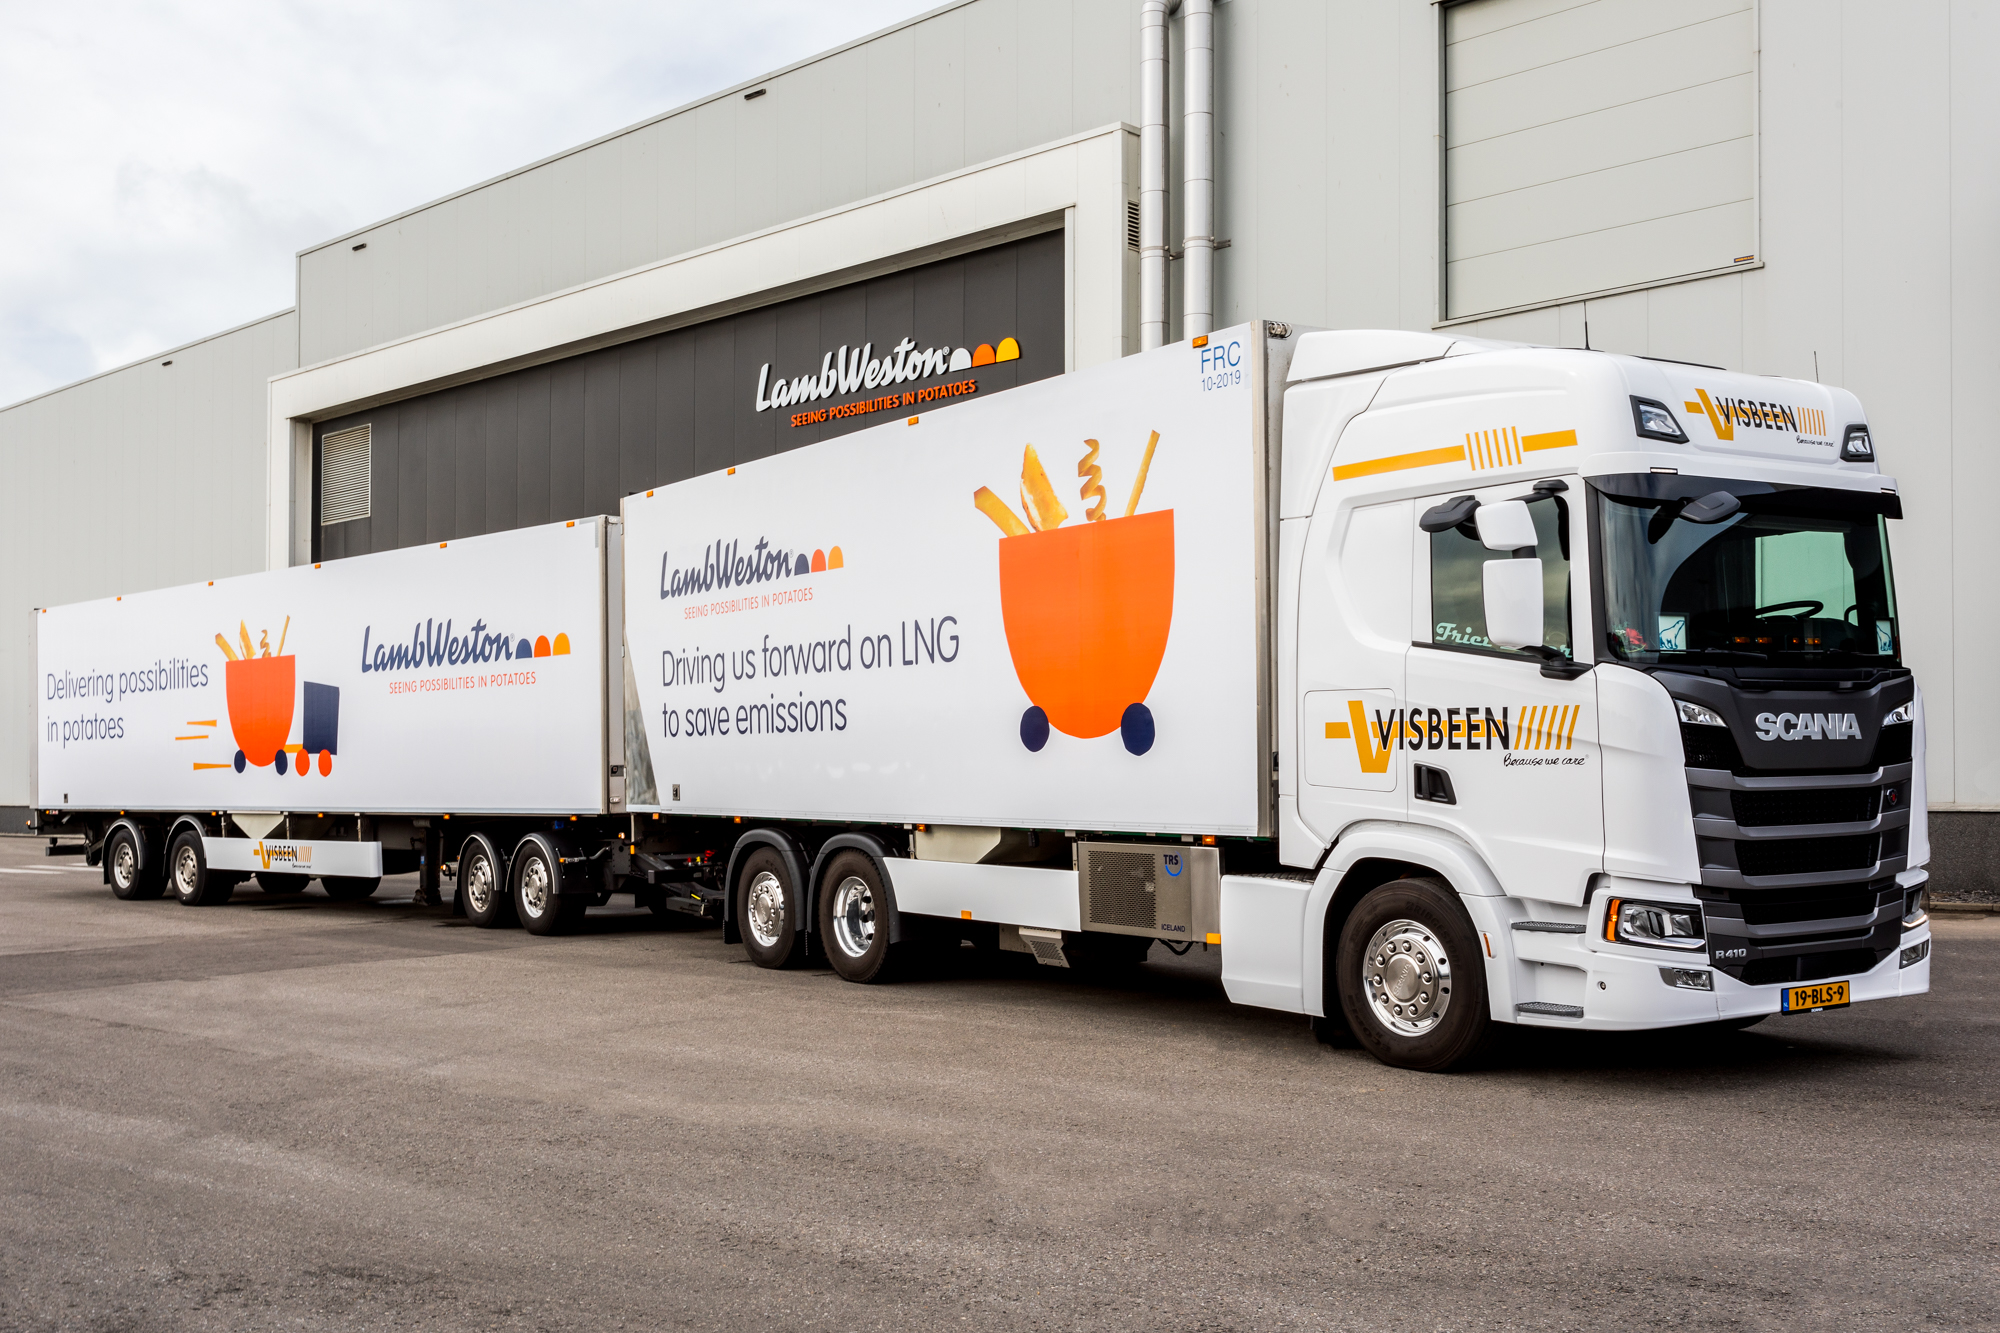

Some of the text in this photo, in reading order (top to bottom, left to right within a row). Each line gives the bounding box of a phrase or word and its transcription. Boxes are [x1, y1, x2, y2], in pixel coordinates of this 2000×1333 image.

[1201, 341, 1241, 374] FRC
[1201, 369, 1241, 392] 10-2019
[790, 379, 977, 428] SEEING POSSIBILITIES IN POTATOES
[1715, 396, 1798, 433] VISBEEN
[684, 587, 814, 620] SEEING POSSIBILITIES IN POTATOES
[662, 615, 960, 693] Driving us forward on LNG
[47, 657, 209, 703] Delivering possibilities
[389, 671, 537, 695] SEEING POSSIBILITIES IN POTATOES
[662, 690, 848, 738] to save emissions
[1374, 706, 1510, 751] VISBEEN
[1755, 712, 1862, 741] SCANIA
[47, 713, 125, 749] in potatoes
[1503, 752, 1586, 767] Because we care
[265, 844, 298, 862] VISBEEN
[1163, 854, 1179, 866] TRS
[1160, 923, 1186, 933] ICELAND
[1794, 985, 1844, 1007] 19-BLS-9
